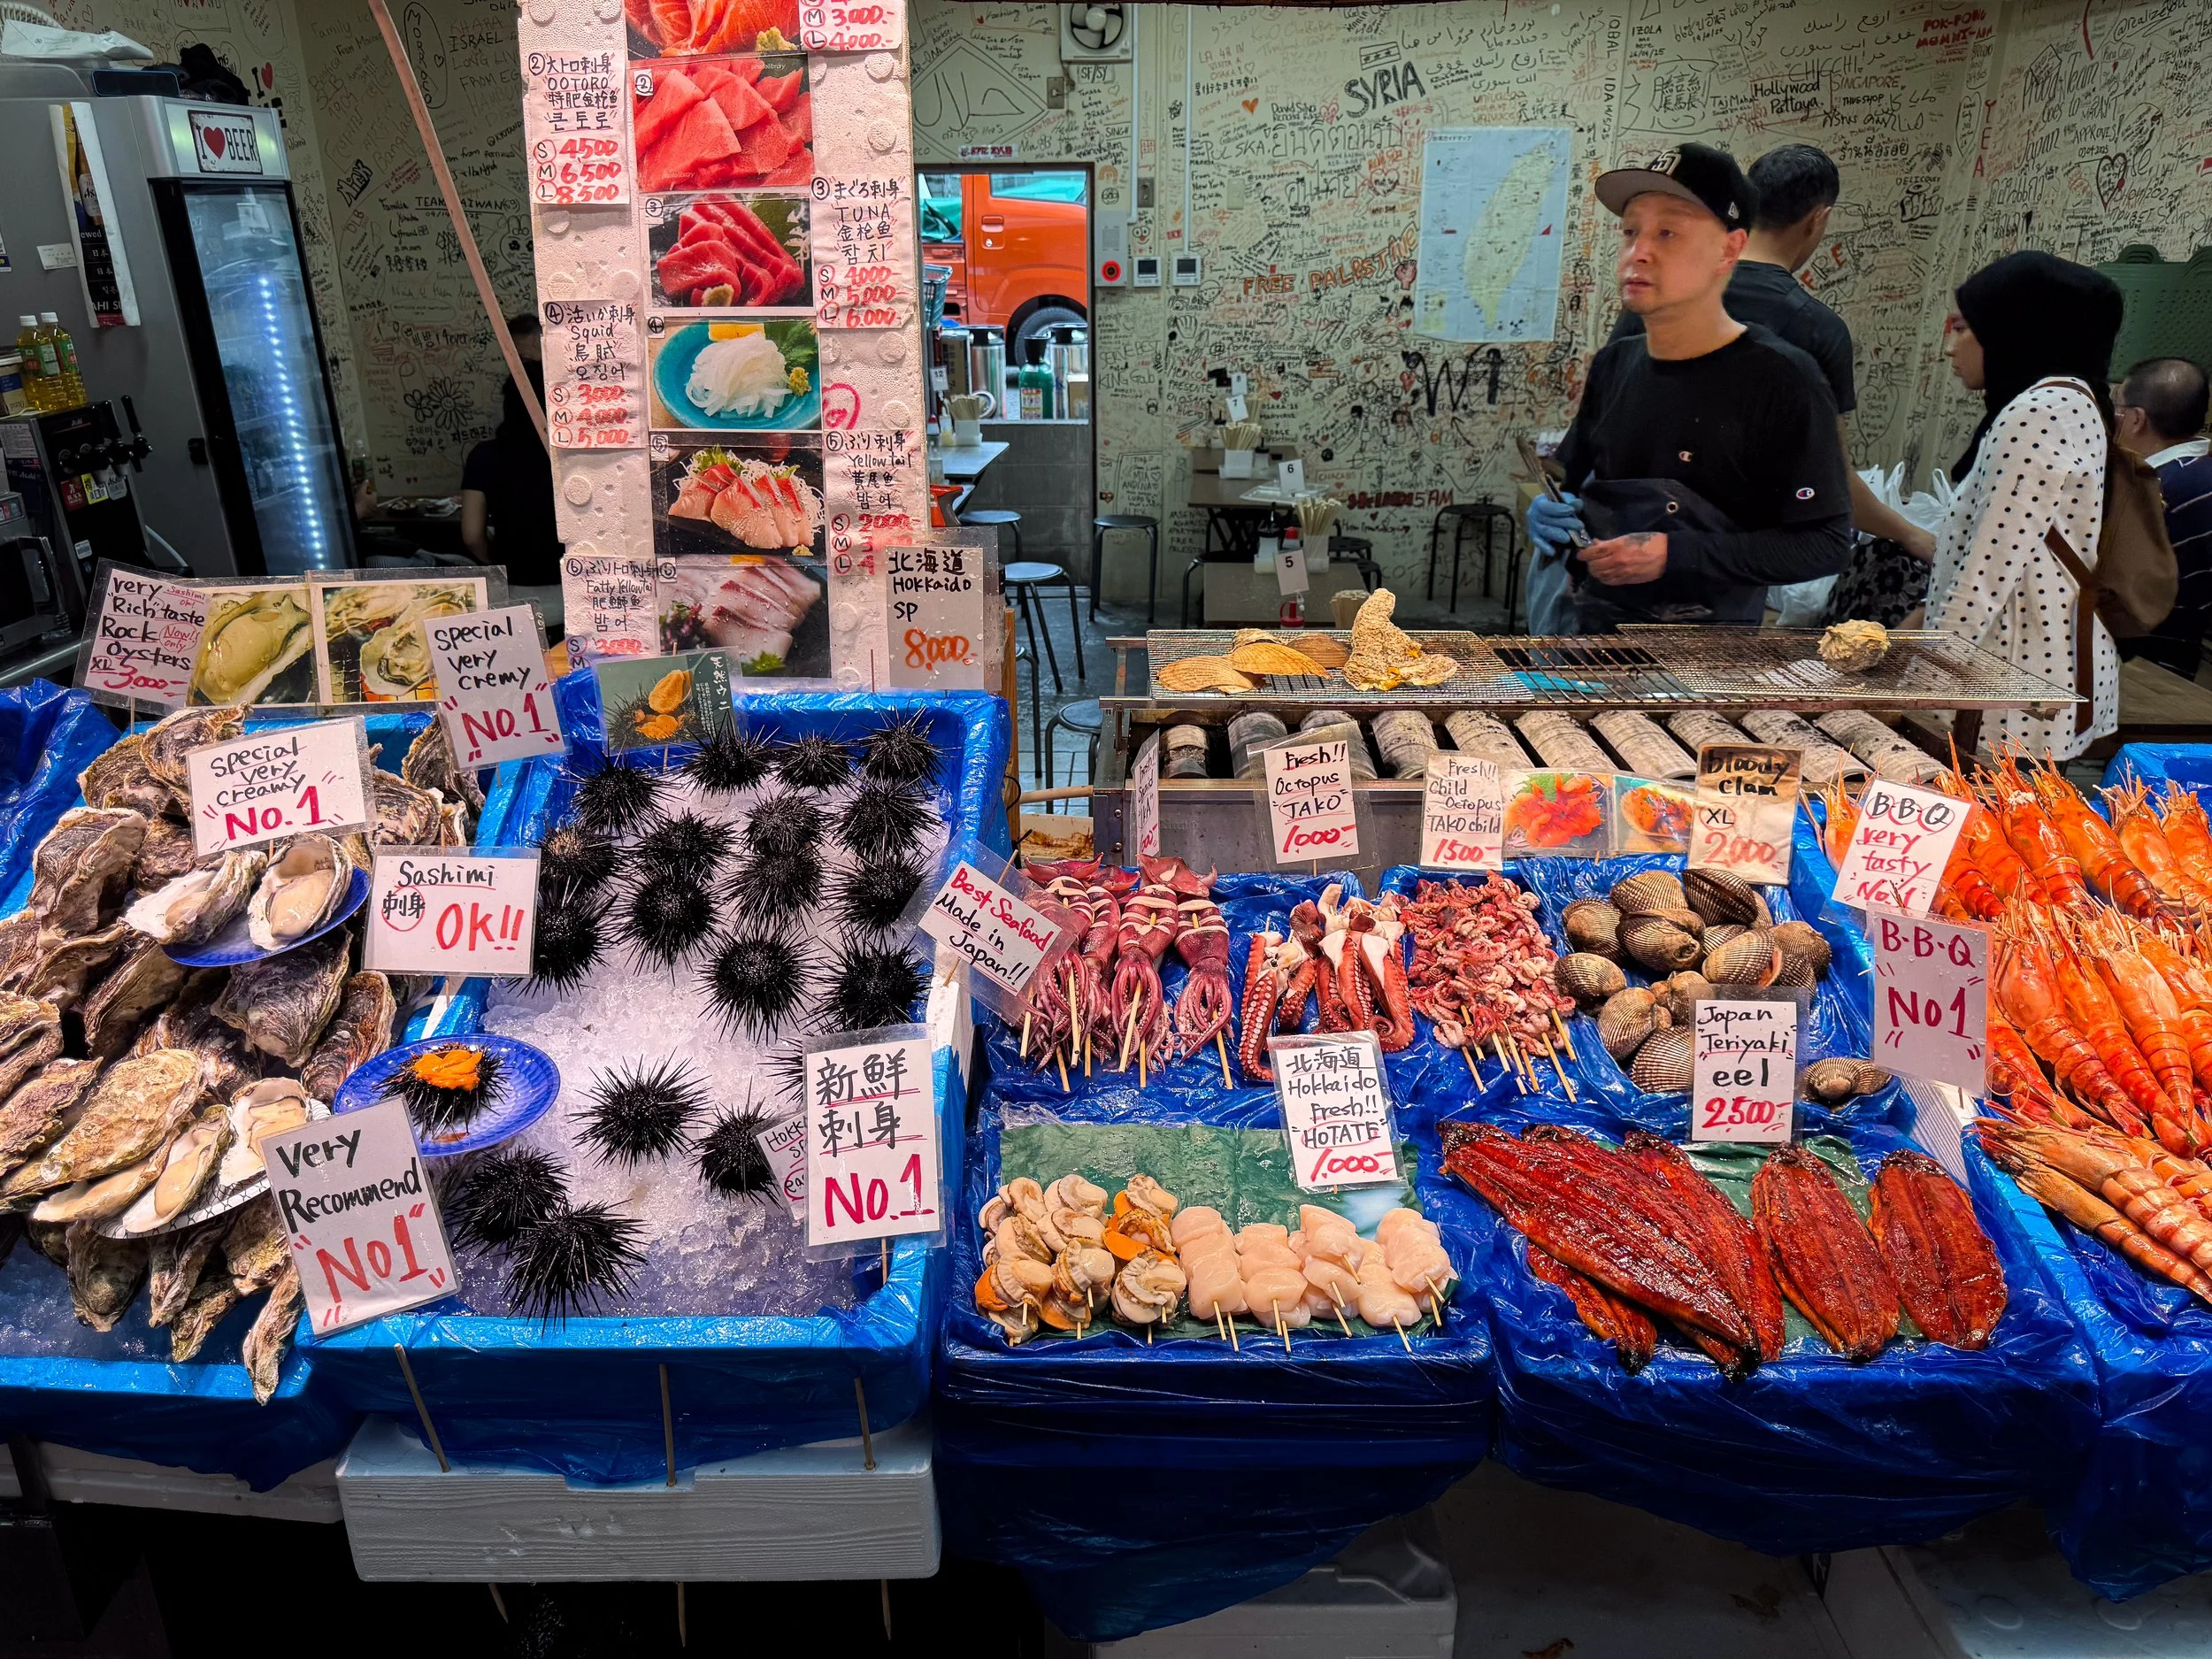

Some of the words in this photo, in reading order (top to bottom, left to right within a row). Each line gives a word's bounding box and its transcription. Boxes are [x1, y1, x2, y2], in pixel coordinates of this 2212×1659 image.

[449, 31, 503, 53] ISRAEL
[1344, 61, 1426, 119] SYRIA
[1754, 71, 1822, 98] Hollywood
[225, 127, 258, 163] BEER
[834, 179, 900, 200] まぐろ刺身
[835, 204, 890, 222] TUNA
[1243, 274, 1296, 296] FREE
[572, 323, 616, 344] Squid
[1286, 463, 1294, 474] 6
[887, 548, 966, 575] 北海道
[1284, 556, 1294, 569] 5
[101, 615, 159, 643] Rock
[161, 603, 206, 628] taste
[710, 657, 732, 711] 天然ウニ
[1707, 749, 1792, 786] bloody
[1275, 772, 1340, 798] Octopus
[1718, 776, 1779, 797] clam
[1445, 797, 1502, 818] Octopus
[1706, 807, 1735, 826] XL
[1863, 826, 1922, 856] very
[397, 860, 496, 887] Sashimi
[1861, 850, 1933, 887] tasty
[382, 889, 426, 920] 刺身
[950, 867, 994, 910] Best
[989, 897, 1056, 952] Seafood
[934, 892, 982, 933] Made
[987, 928, 1005, 951] in
[1696, 1005, 1774, 1034] Japan
[1286, 1046, 1378, 1075] 北海道
[1700, 1030, 1791, 1064] Teriyaki
[815, 1048, 909, 1106] 新鮮
[1287, 1070, 1378, 1099] Hokkaido
[1712, 1057, 1770, 1087] eel
[817, 1101, 902, 1158] 刺身
[278, 1156, 424, 1234] Recommend
